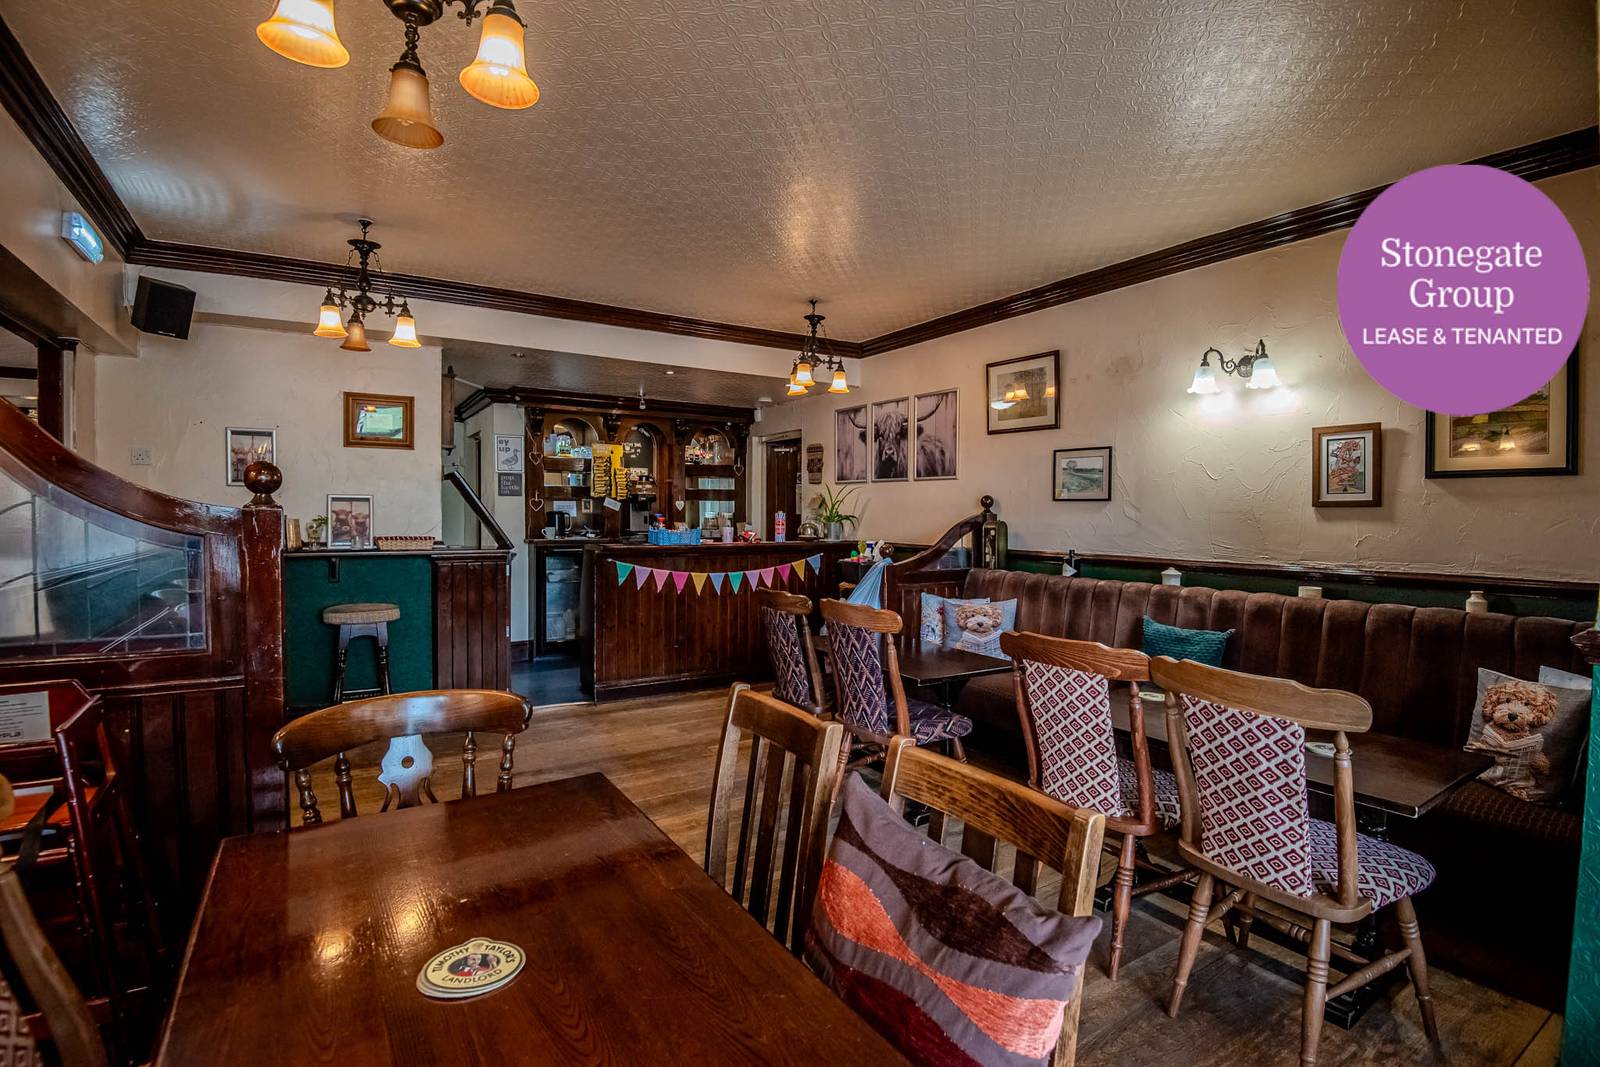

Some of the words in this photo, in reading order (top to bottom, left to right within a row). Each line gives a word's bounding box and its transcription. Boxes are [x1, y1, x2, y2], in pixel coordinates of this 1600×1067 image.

[432, 946, 470, 973] TIMOTHY
[483, 943, 516, 964] TAYLOR'S
[441, 969, 503, 985] LANDLORD
